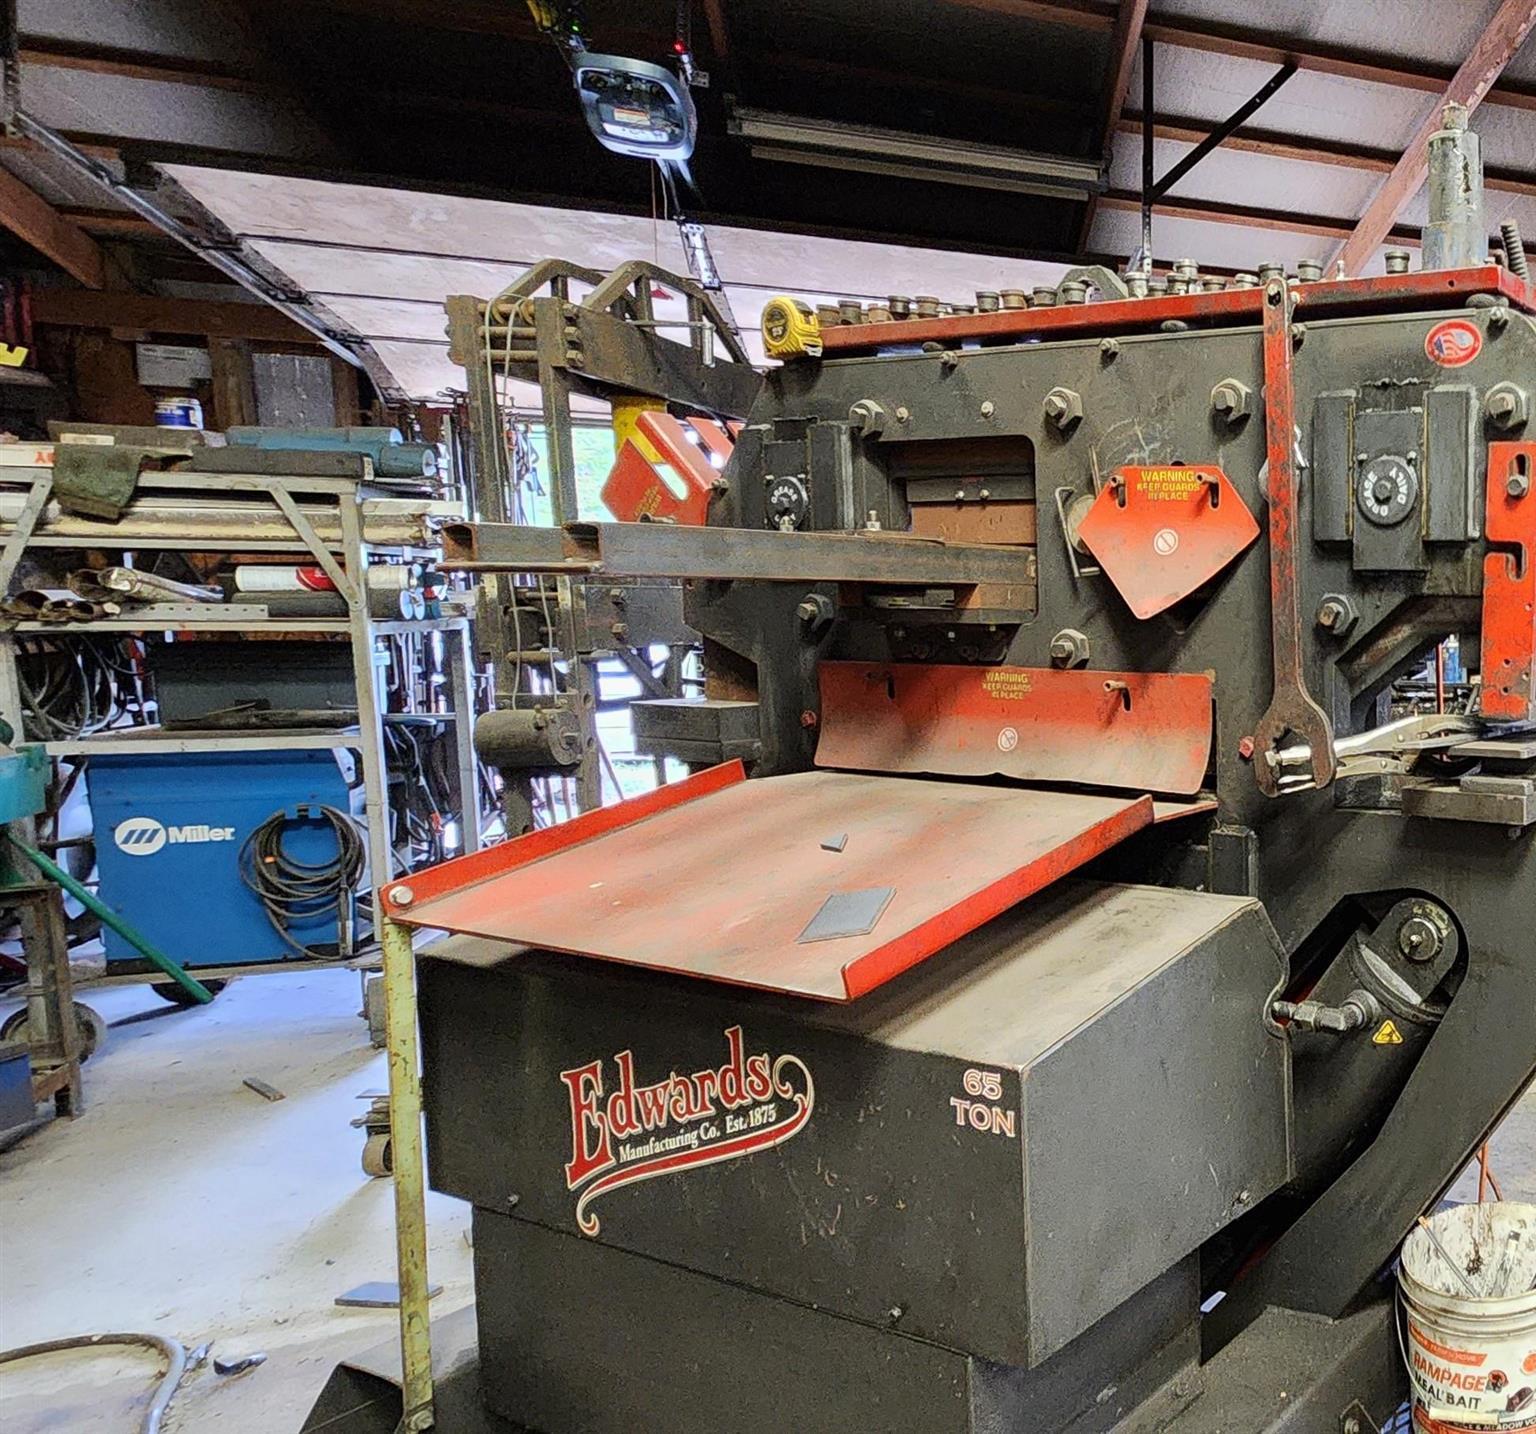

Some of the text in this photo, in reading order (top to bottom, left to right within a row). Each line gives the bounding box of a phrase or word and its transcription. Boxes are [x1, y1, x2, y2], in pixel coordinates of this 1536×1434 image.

[1141, 470, 1195, 482] WARNING
[1136, 482, 1201, 492] KEEP GUARDS
[1159, 491, 1189, 501] PLACE
[1363, 466, 1408, 517] GREASE DAILY
[985, 672, 1028, 683] WARNING
[982, 683, 1033, 693] KEEP GUARDS
[1000, 691, 1024, 700] PLACE
[168, 824, 235, 844] Miller
[963, 1068, 1003, 1101] 65
[560, 1024, 774, 1191] Edwards
[949, 1095, 1016, 1138] TON
[619, 1103, 777, 1163] Manufacturing Co. Est. 1875
[1412, 1350, 1488, 1393] RAMPAGE
[1446, 1391, 1482, 1410] BAIT
